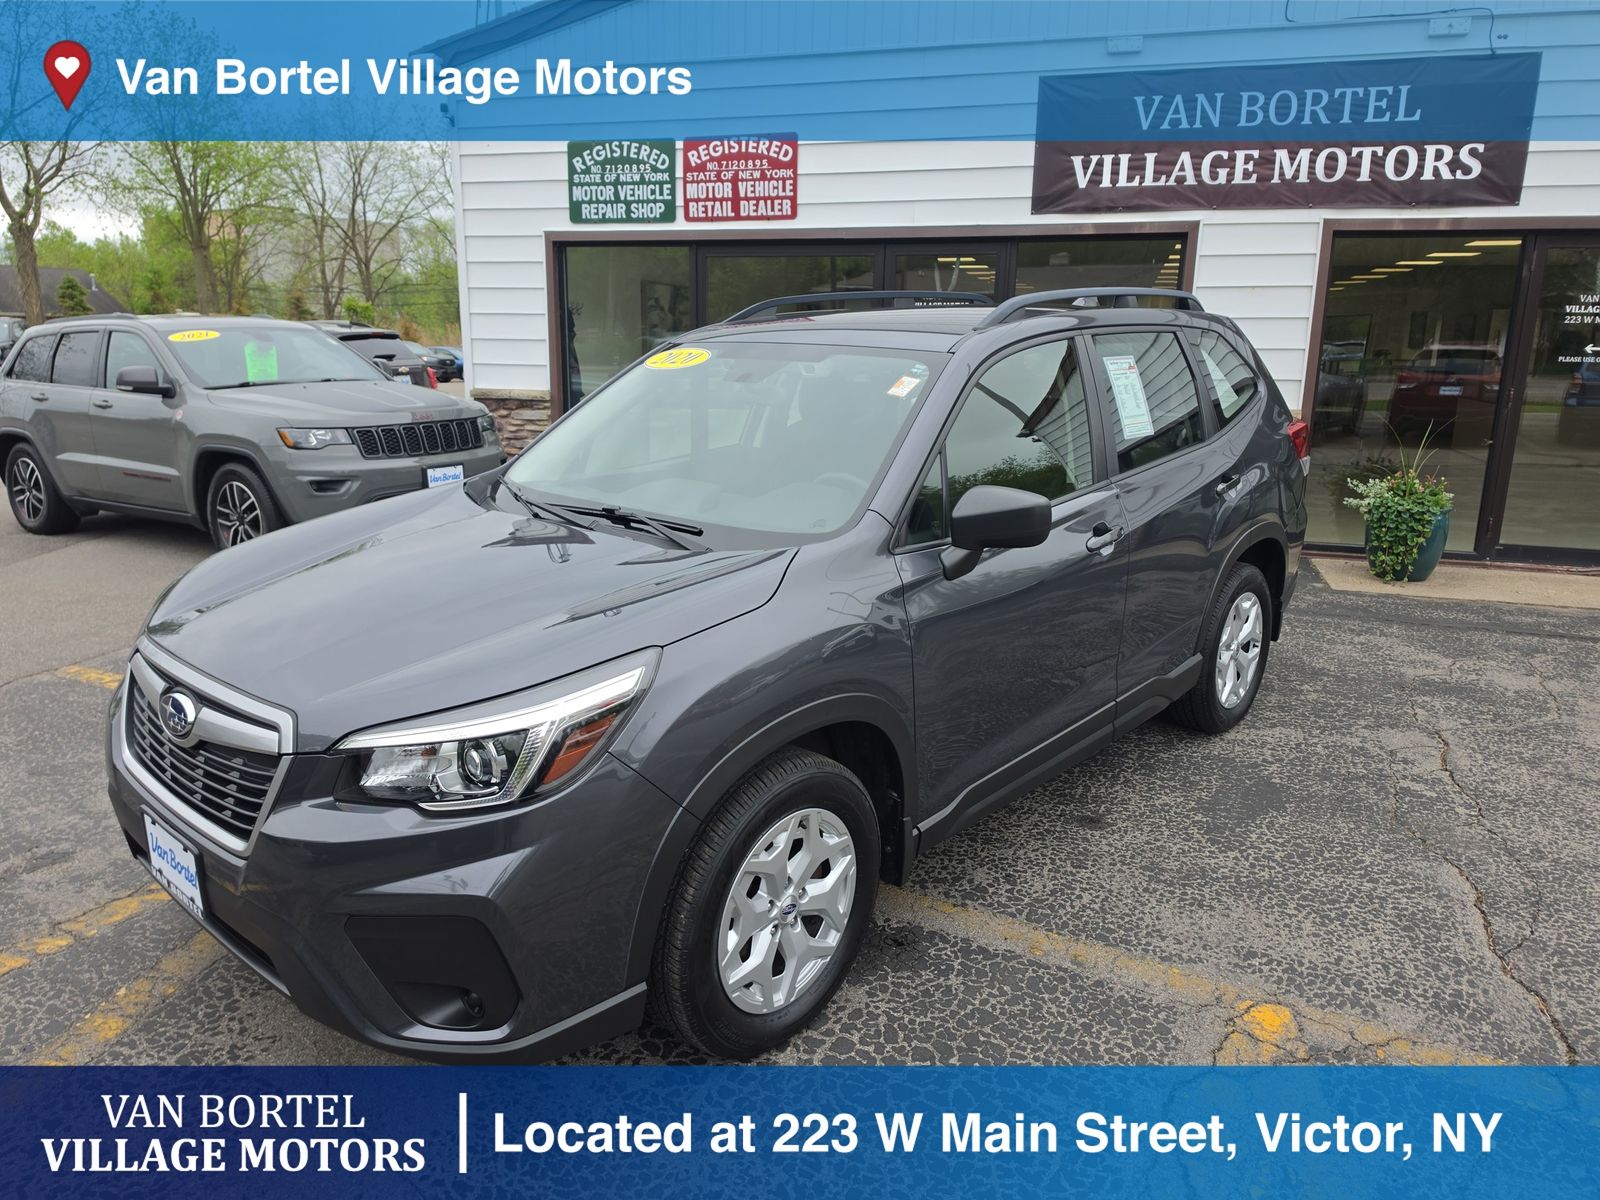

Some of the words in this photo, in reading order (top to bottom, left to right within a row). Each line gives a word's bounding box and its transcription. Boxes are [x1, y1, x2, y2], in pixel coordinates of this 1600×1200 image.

[1134, 92, 1225, 131] VAN
[1237, 85, 1422, 128] BORTEL
[572, 141, 670, 172] REGISTERED
[687, 136, 794, 167] REGISTERED
[605, 164, 652, 173] 7120895
[721, 159, 769, 169] 7120895
[1070, 149, 1260, 189] VILLAGE
[1270, 143, 1486, 184] MOTORS
[573, 174, 602, 183] STATE
[604, 173, 618, 183] OF
[619, 173, 641, 182] NEW
[646, 172, 670, 182] YORK
[686, 172, 717, 181] STATE
[720, 171, 734, 180] OF
[738, 170, 761, 179] NEW
[764, 169, 794, 179] YORK
[572, 185, 615, 201] MOTOR
[618, 184, 672, 201] VEHICLE
[686, 182, 732, 199] MOTOR
[738, 180, 794, 198] VEHICLE
[581, 203, 626, 219] REPAIR
[630, 202, 665, 218] SHOP
[688, 201, 735, 218] RETAIL
[739, 199, 792, 217] DEALER
[1580, 294, 1600, 303] VAN
[1564, 315, 1581, 324] 223
[1583, 315, 1594, 324] W
[648, 352, 706, 365] 2020
